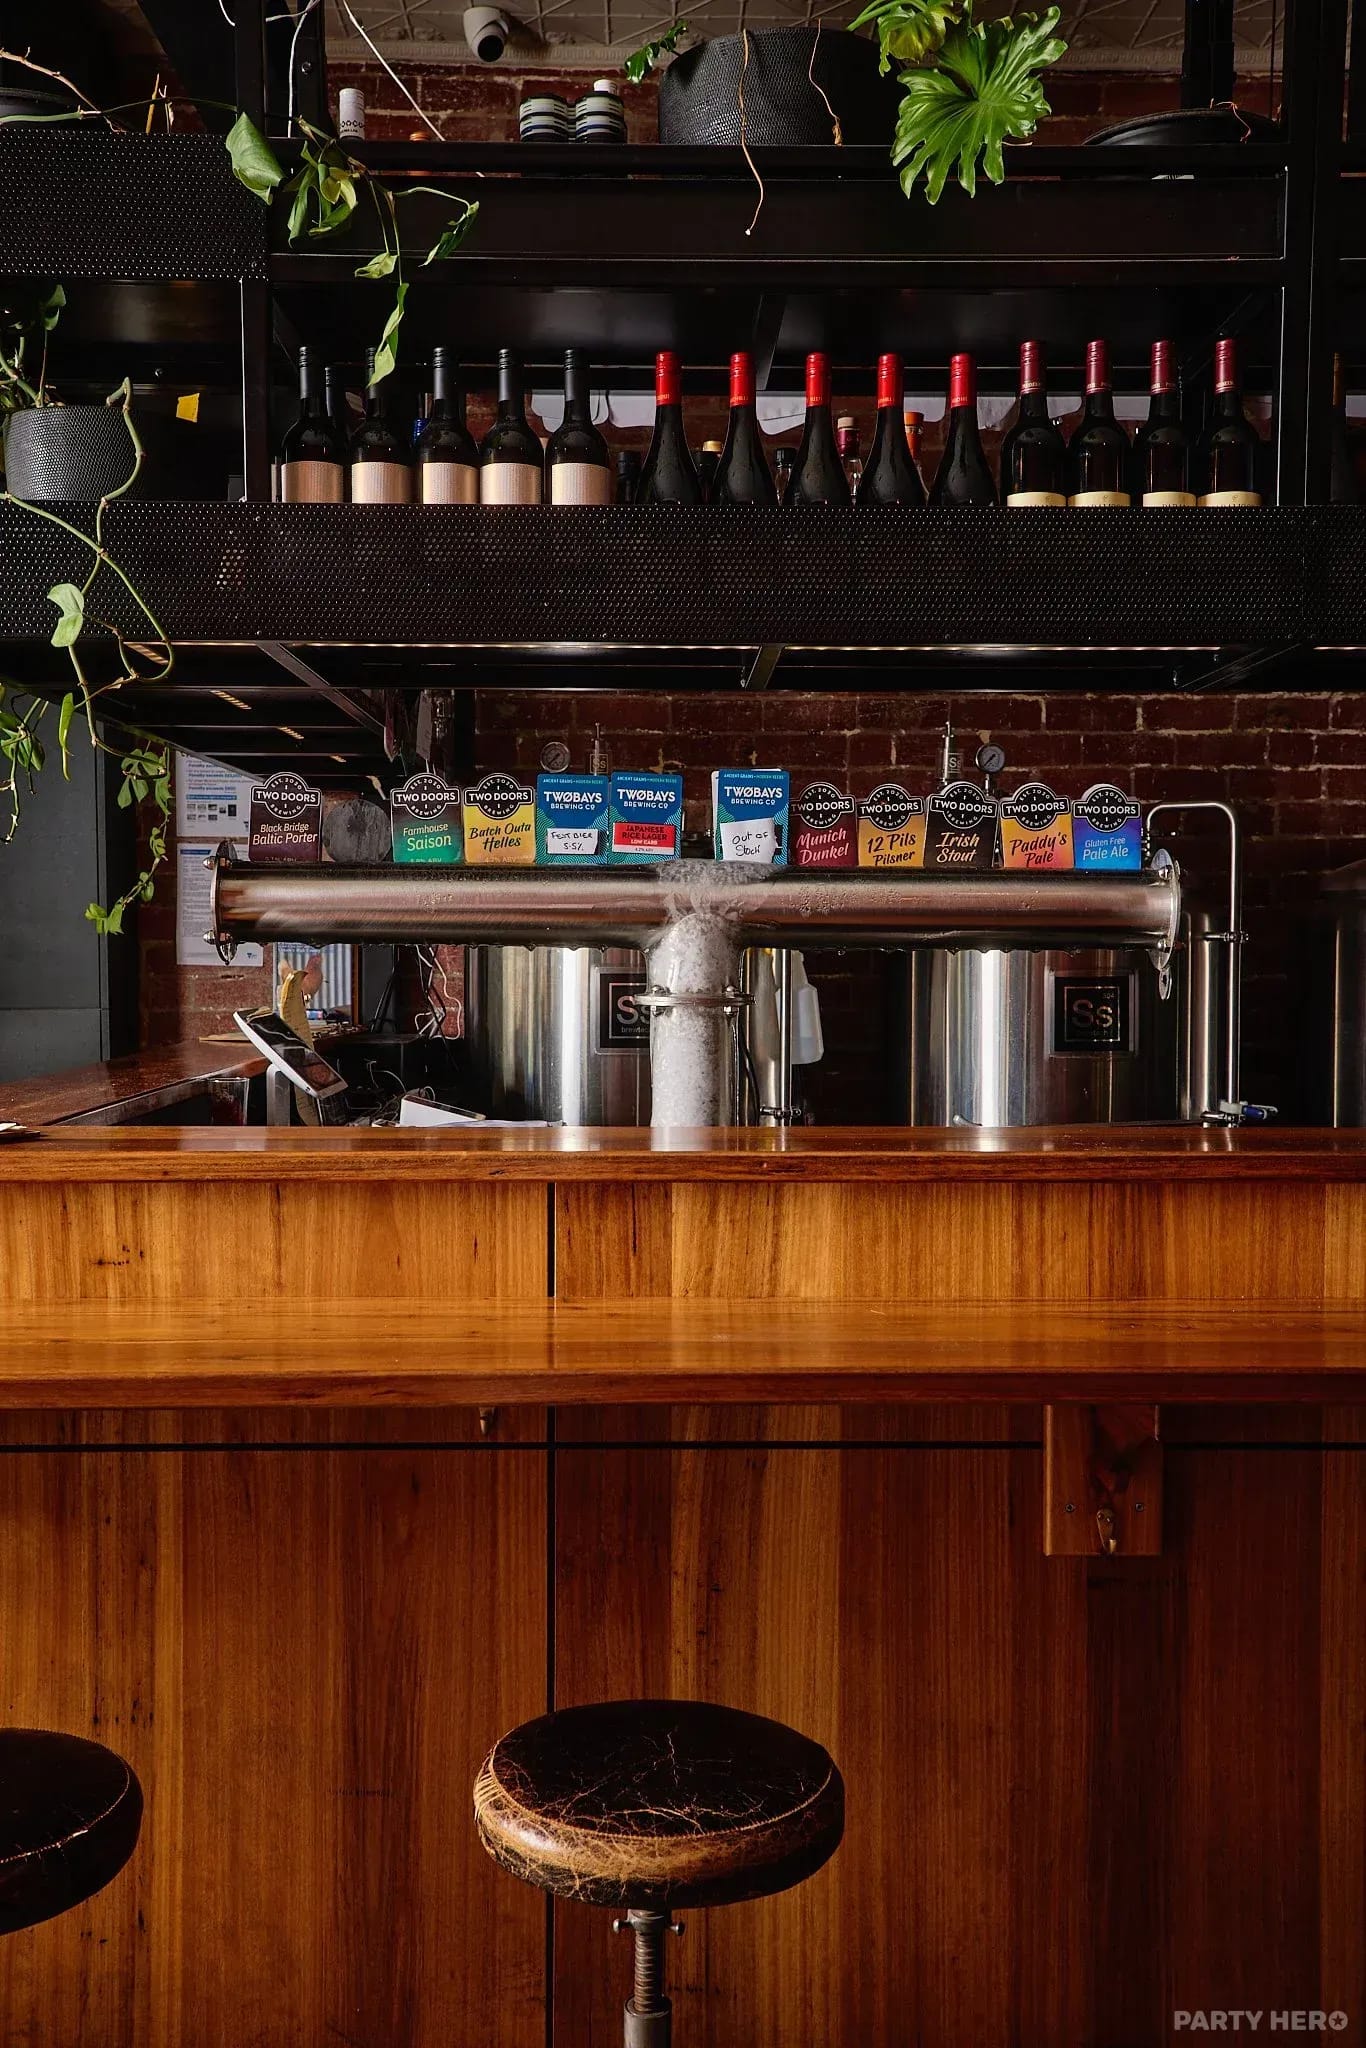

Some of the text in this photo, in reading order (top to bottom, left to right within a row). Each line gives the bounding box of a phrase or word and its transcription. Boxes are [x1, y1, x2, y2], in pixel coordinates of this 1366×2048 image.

[285, 777, 302, 790] 2020
[424, 779, 441, 789] 2020
[496, 778, 514, 789] 2020
[256, 791, 316, 802] TWO DOORS
[396, 792, 456, 802] TWO DOORS
[469, 792, 529, 801] TWO DOORS
[818, 787, 836, 798] 2020
[886, 790, 904, 800] 2020
[963, 788, 980, 801] 2020
[1032, 789, 1050, 799] 2020
[1105, 791, 1123, 803] 2020
[270, 804, 301, 815] BREWING
[411, 805, 442, 816] BREWING
[483, 804, 515, 815] BREWING
[790, 800, 850, 811] TWO DOORS
[860, 801, 919, 814] TWO DOORS
[935, 800, 993, 814] TWO DOORS
[1006, 801, 1065, 814] TWO DOORS
[1077, 805, 1136, 814] TWO DOORS
[805, 813, 837, 825] BREWING
[875, 815, 906, 827] BREWING
[947, 813, 978, 825] BREWING
[1021, 815, 1052, 826] BREWING
[1091, 818, 1122, 828] BREWING
[260, 822, 310, 833] Black Bridge
[403, 823, 449, 837] Farmhouse
[468, 822, 532, 840] Batch Outa
[625, 825, 665, 834] JAPANESE
[252, 832, 318, 845] Baltic Porter
[622, 831, 668, 840] RICE LAGER
[795, 827, 847, 849] Munich
[935, 831, 980, 848] Irish
[407, 835, 452, 852] Saison
[483, 836, 521, 853] Helles
[867, 832, 916, 854] 12 Pils
[1009, 831, 1068, 856] Paddy's
[1084, 837, 1126, 848] Gluten Free
[735, 844, 761, 857] Stock
[799, 842, 850, 865] Dunkel
[936, 847, 977, 863] Stout
[1082, 845, 1129, 861] Pale Ale
[873, 850, 916, 866] Pilsner
[1024, 850, 1054, 868] Pale
[1072, 999, 1113, 1028] Ss
